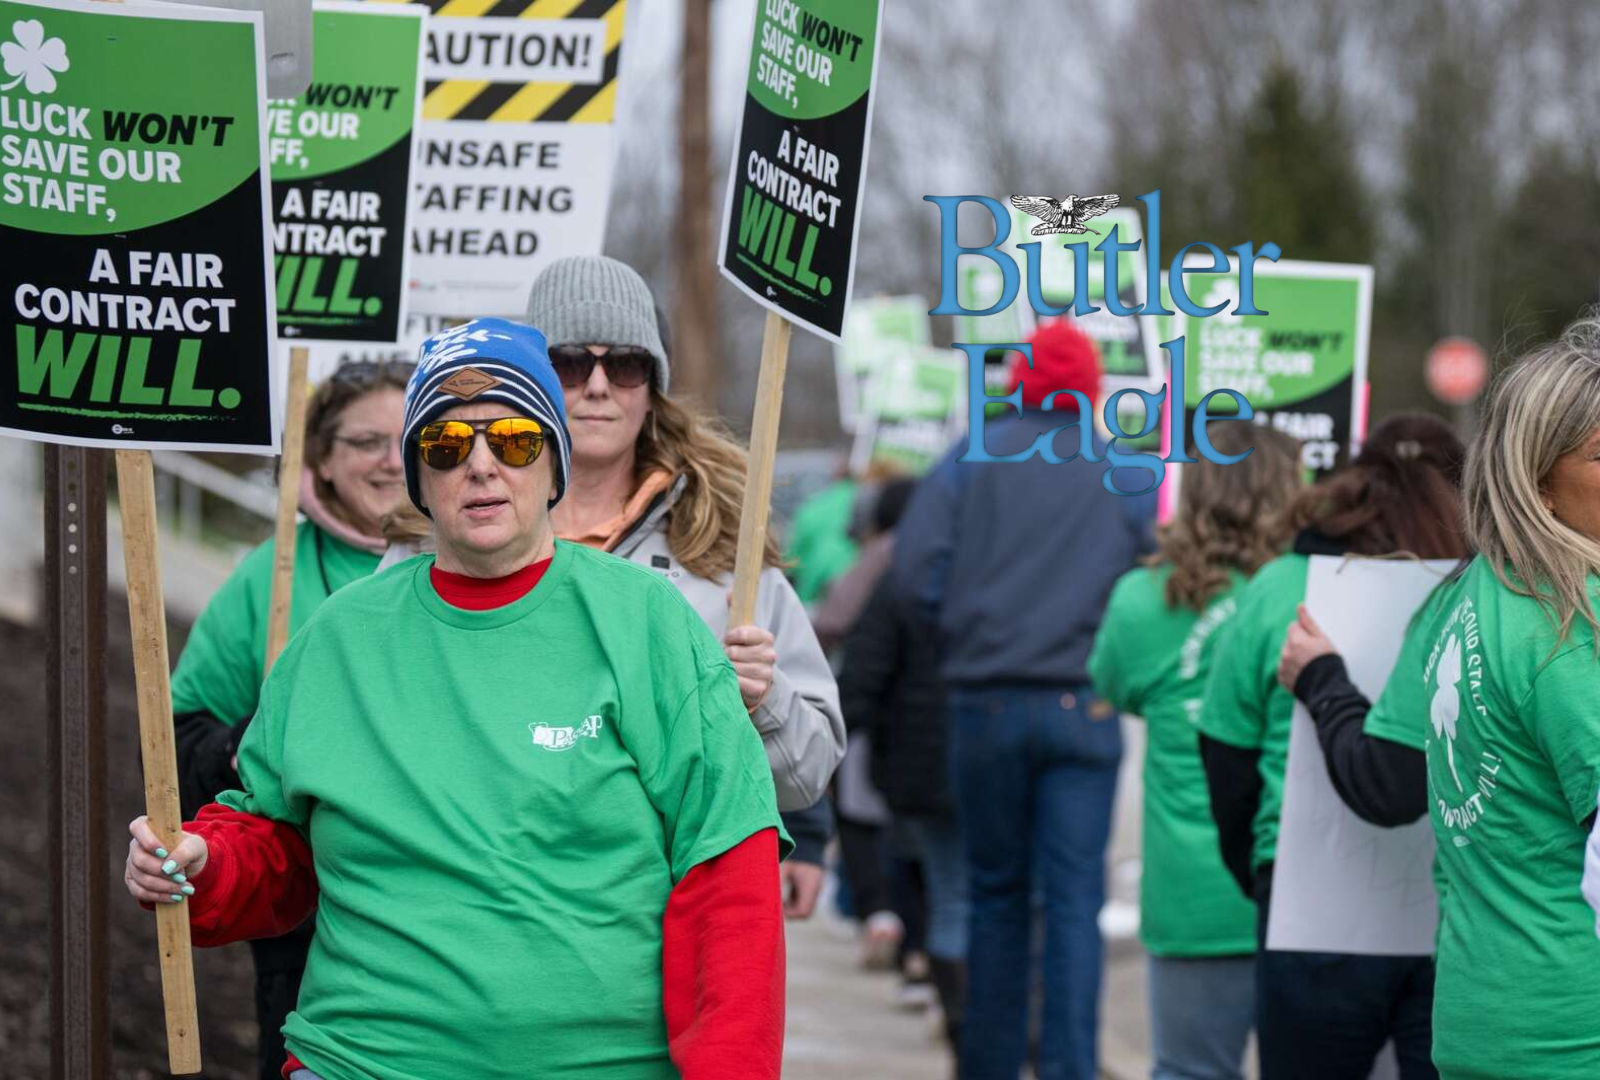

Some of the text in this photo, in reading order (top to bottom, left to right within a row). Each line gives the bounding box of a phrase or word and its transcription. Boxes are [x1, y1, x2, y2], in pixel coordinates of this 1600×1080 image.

[426, 32, 591, 67] AUTION!
[761, 20, 833, 87] SAVE OUR
[765, 0, 863, 62] LUCK WON'T
[305, 83, 399, 110] WON'T
[757, 53, 798, 109] STAFF,
[1, 96, 235, 147] LUCK WON'T
[298, 110, 360, 139] OUR
[1, 134, 182, 184] SAVE OUR
[269, 138, 310, 169] FF,
[418, 140, 561, 168] NSAFE
[776, 129, 840, 187] A FAIR
[3, 172, 117, 223] STAFF,
[280, 187, 382, 222] A FAIR
[416, 184, 573, 212] AFFING
[747, 150, 841, 228] CONTRACT
[271, 222, 387, 258] NTRACT
[738, 184, 832, 297] WILL.
[89, 248, 224, 289] A FAIR
[274, 254, 383, 317] ILL.
[15, 283, 236, 333] CONTRACT
[15, 323, 241, 410] WILL.
[1261, 350, 1316, 377] OUR
